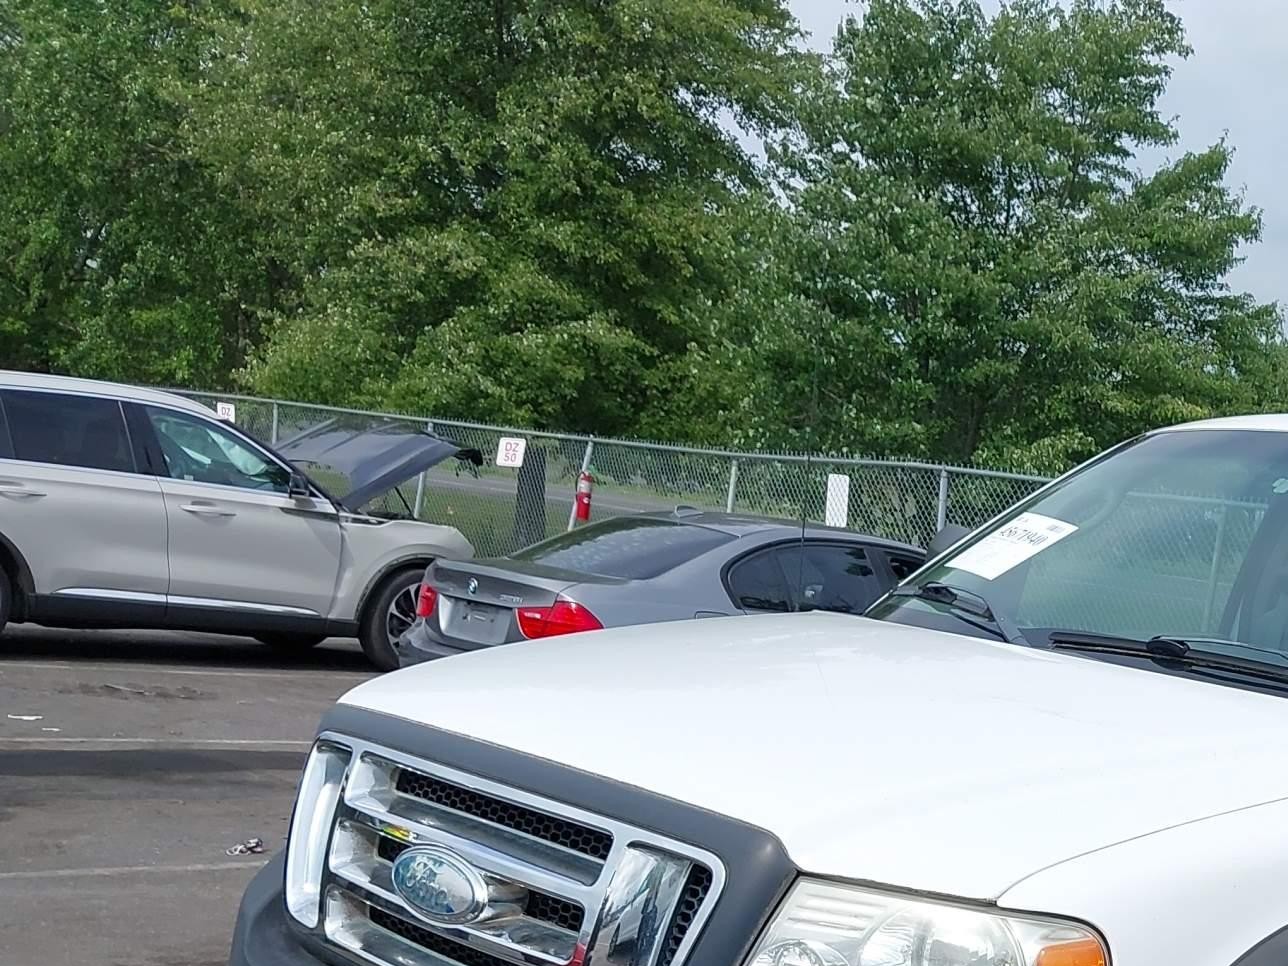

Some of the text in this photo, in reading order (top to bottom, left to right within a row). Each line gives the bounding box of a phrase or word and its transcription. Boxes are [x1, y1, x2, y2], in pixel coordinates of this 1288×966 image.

[221, 406, 231, 417] DZ
[504, 441, 520, 453] DZ
[503, 453, 517, 463] 50
